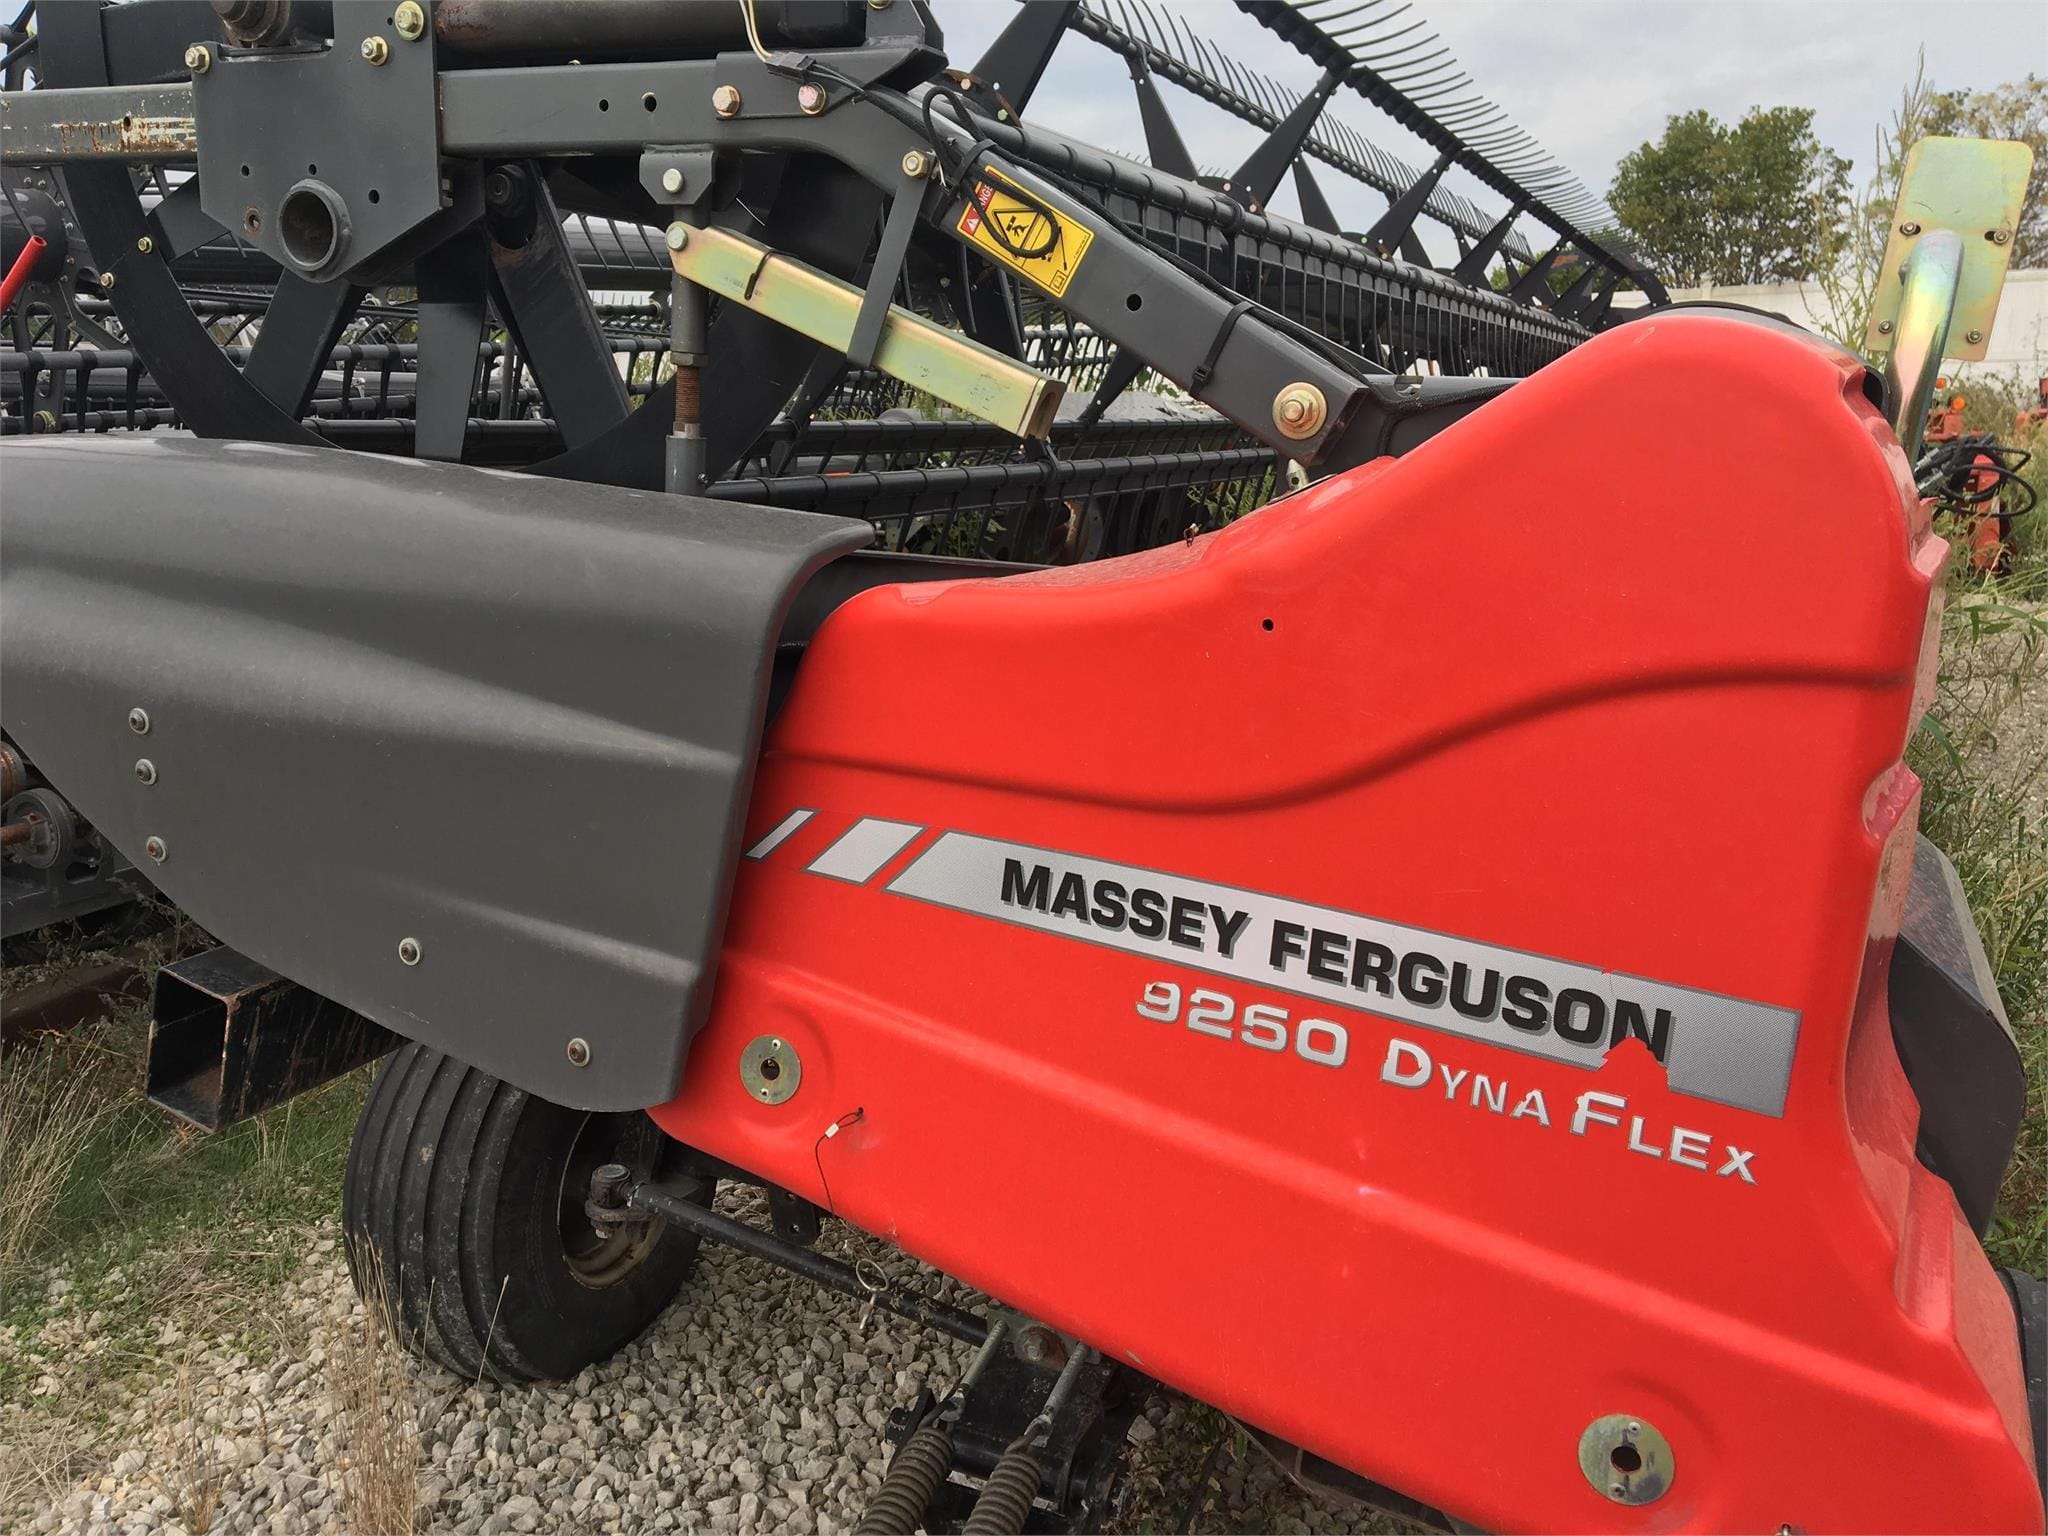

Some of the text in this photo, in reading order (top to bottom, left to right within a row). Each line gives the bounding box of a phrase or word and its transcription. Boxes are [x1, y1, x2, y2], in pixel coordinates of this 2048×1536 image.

[1000, 857, 1677, 1069] MASSEY FERGUSON
[1136, 981, 1348, 1068] 9250
